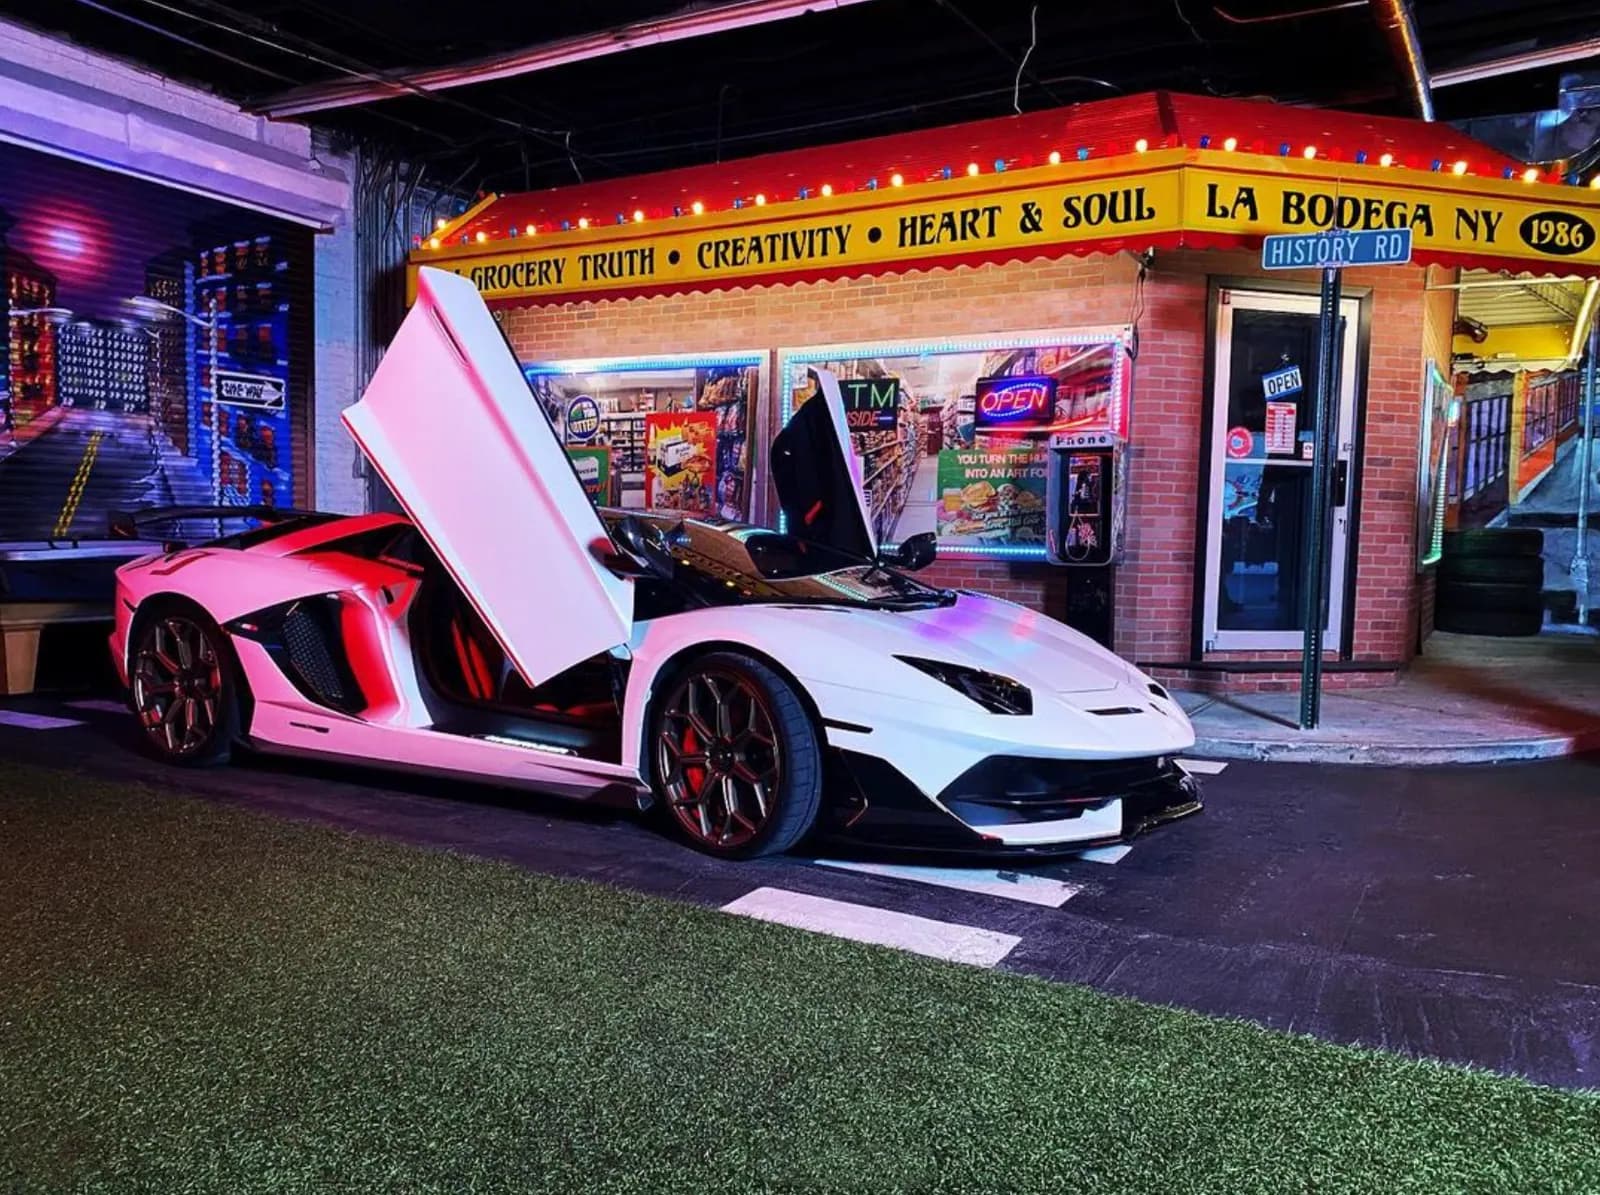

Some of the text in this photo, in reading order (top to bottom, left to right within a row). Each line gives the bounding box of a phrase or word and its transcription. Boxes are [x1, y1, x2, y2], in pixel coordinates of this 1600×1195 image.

[1206, 183, 1504, 243] LA BODEGA NY
[471, 187, 1156, 292] GROCERY TRUTH CREATIVITY HEART & SOUL
[1530, 218, 1585, 249] 1986
[1271, 234, 1403, 265] HISTORY RD
[1268, 371, 1299, 394] OPEN
[847, 383, 896, 408] TM
[981, 387, 1047, 412] OPEN
[1056, 435, 1106, 446] Phone
[957, 454, 977, 464] YOU
[980, 453, 1007, 465] TURN
[1008, 454, 1028, 465] THE
[965, 468, 988, 478] INTO
[989, 468, 1005, 478] AN
[1006, 468, 1029, 478] ART
